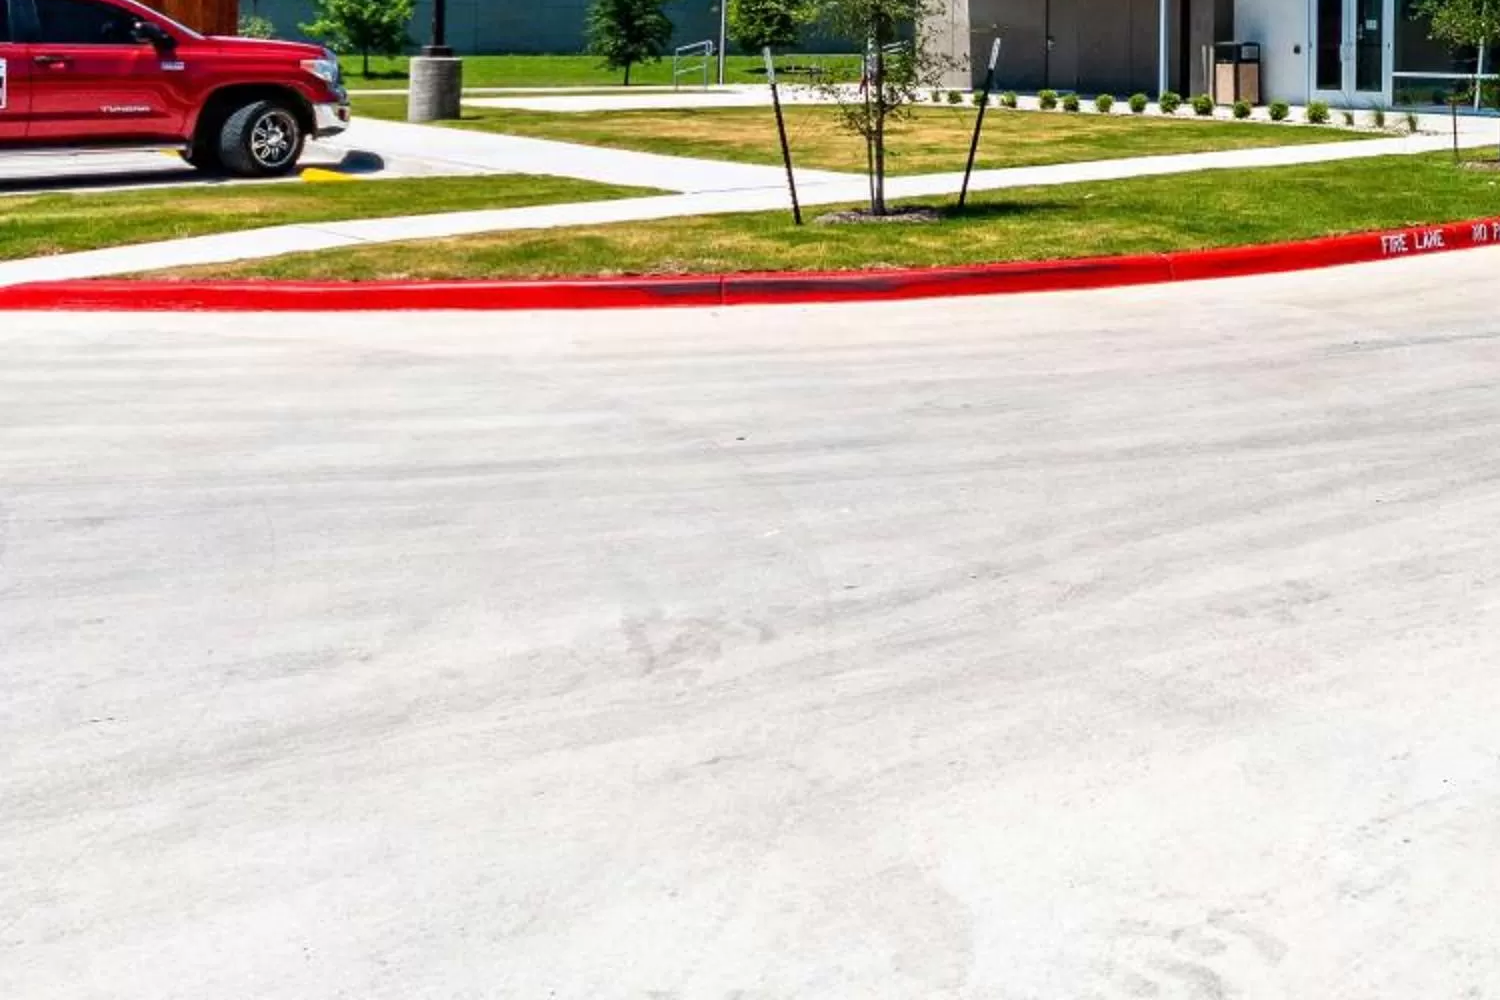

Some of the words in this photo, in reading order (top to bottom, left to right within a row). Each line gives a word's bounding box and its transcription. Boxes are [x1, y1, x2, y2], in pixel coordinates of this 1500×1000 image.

[1381, 234, 1408, 255] FIRE
[1414, 229, 1445, 250] LANE
[1472, 224, 1487, 241] NO
